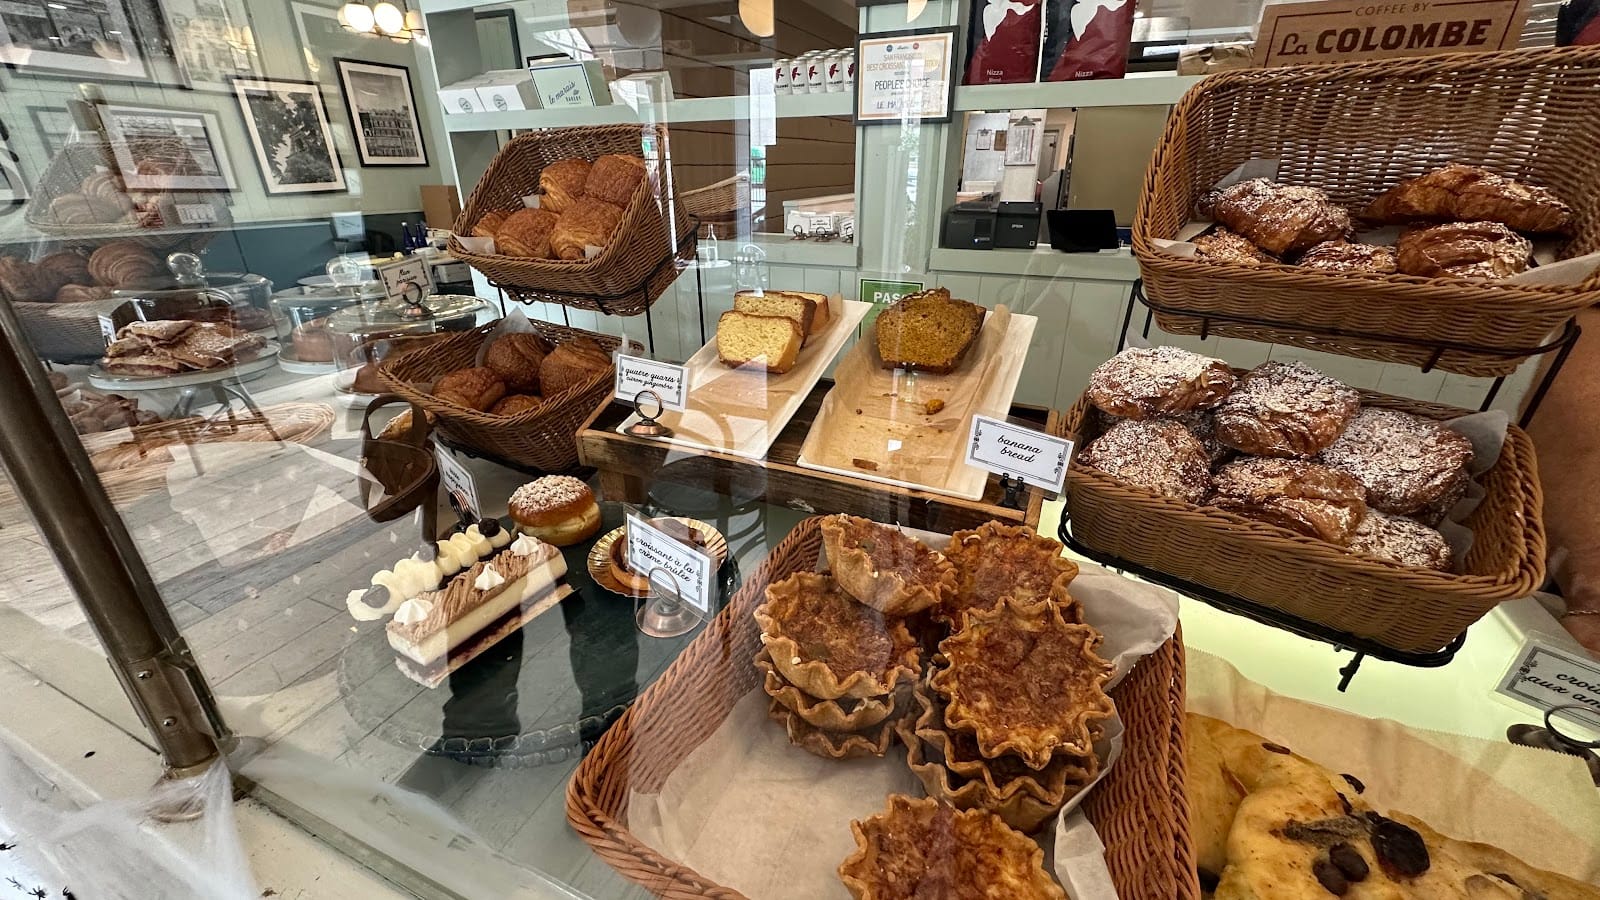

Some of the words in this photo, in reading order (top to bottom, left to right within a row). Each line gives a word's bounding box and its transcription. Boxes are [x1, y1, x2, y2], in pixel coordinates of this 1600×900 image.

[1355, 3, 1406, 17] COFFEE
[1413, 2, 1430, 12] BY
[1277, 32, 1308, 56] La
[1315, 19, 1492, 54] COLOMBE
[866, 63, 879, 72] BEST
[873, 291, 905, 304] PAS
[625, 367, 650, 378] quatre
[997, 435, 1043, 454] banana
[1000, 446, 1036, 463] bread
[635, 537, 674, 562] croissant
[674, 557, 682, 567] à
[683, 562, 695, 574] la
[638, 548, 662, 565] crème
[663, 561, 691, 582] brûlée
[1526, 676, 1570, 694] aux
